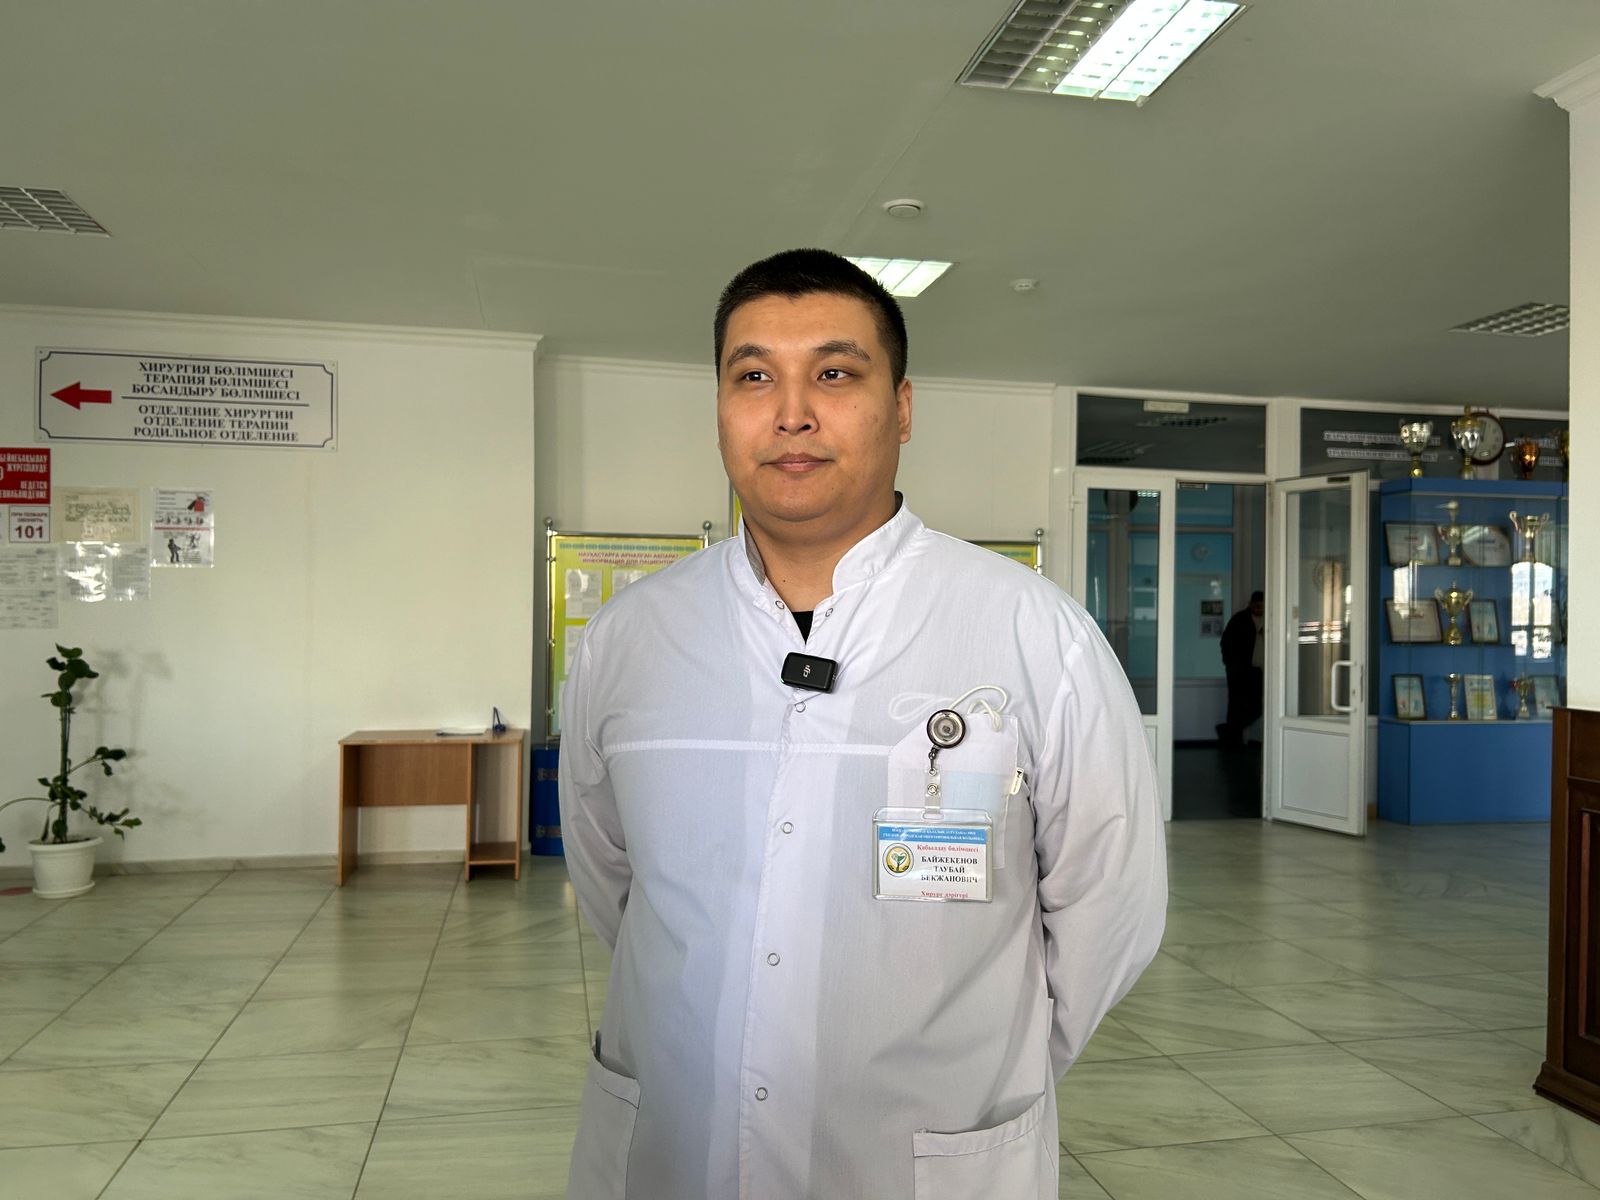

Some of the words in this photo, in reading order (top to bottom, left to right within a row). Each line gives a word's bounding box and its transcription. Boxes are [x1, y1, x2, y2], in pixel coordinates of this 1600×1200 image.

[139, 362, 211, 375] ХИРУРГИЯ
[144, 373, 205, 385] ТЕРАПИЯ
[132, 384, 217, 397] БОСАНДЫРУ
[138, 405, 220, 417] ОТДЕЛЕНИЕ
[224, 408, 294, 420] ХИРУРГИИ
[143, 416, 225, 428] ОТДЕЛЕНИЕ
[230, 420, 289, 430] ТЕРАПИИ
[134, 427, 216, 439] РОДИЛЬНОЕ
[220, 430, 299, 442] ОТДЕЛЕНИЕ
[15, 525, 43, 539] 101
[921, 855, 978, 865] БАЙЖЕКЕНОВ
[933, 865, 965, 874] ТАУБАЙ
[921, 874, 978, 884] БЕКЖАНОВИЧ
